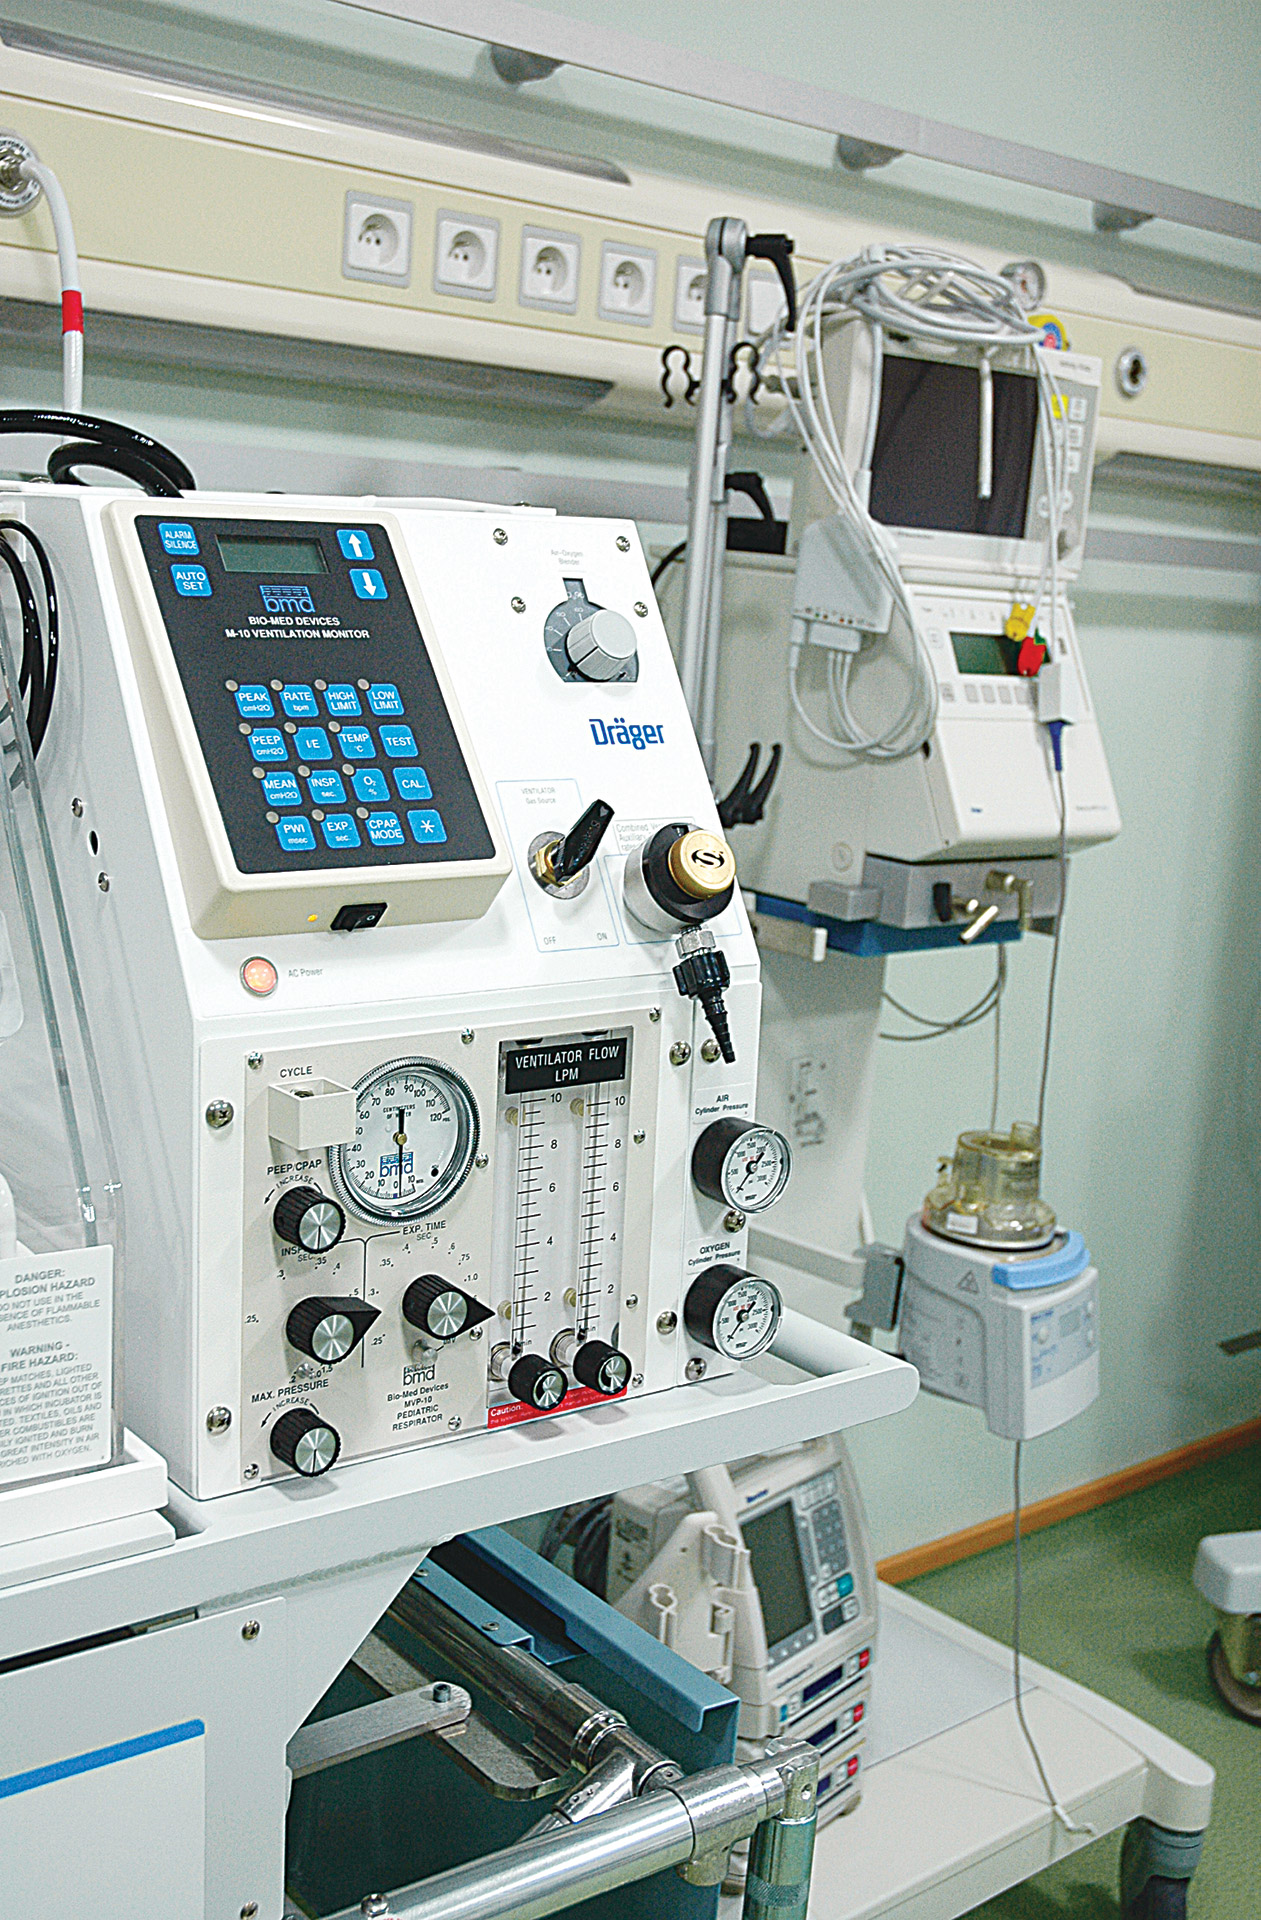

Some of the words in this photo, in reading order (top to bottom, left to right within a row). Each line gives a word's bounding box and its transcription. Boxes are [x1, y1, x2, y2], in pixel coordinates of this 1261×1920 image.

[164, 530, 192, 540] ALARM
[164, 540, 197, 550] SILENCE
[176, 572, 206, 581] AUTO
[182, 582, 204, 591] SET
[248, 616, 294, 626] BIO-MED
[296, 616, 340, 626] DEVICES
[224, 629, 250, 638] M-10
[251, 629, 321, 638] VENTILATION
[322, 630, 370, 638] MONITOR
[238, 692, 269, 702] PEAK
[284, 692, 312, 701] RATE
[328, 691, 354, 700] HIGH
[372, 690, 396, 700] LOW
[293, 704, 310, 713] bpm
[330, 702, 358, 711] LIMIT
[374, 700, 399, 710] LIMIT
[340, 733, 370, 743] TEMP
[588, 717, 665, 750] Dräger
[252, 736, 281, 745] PEEP
[386, 736, 412, 746] TEST
[264, 780, 297, 789] MEAN
[311, 778, 340, 788] INSP.
[402, 780, 426, 789] CAL.
[521, 786, 556, 795] VENTILATOR
[284, 824, 306, 834] PWI
[326, 821, 352, 832] EXP.
[369, 818, 397, 830] CPAP
[616, 823, 650, 833] Combined
[370, 828, 403, 840] MODE
[543, 935, 558, 946] OFF
[596, 932, 608, 942] ON
[288, 968, 300, 978] AC
[300, 966, 324, 978] Power
[515, 1049, 583, 1070] VENTILATOR
[588, 1045, 620, 1062] FLOW
[280, 1066, 313, 1078] CYCLE
[555, 1067, 579, 1083] LPM
[384, 1088, 395, 1096] 80
[404, 1084, 414, 1094] 90
[414, 1088, 426, 1098] 100
[371, 1098, 382, 1107] 70
[425, 1098, 436, 1108] 110
[550, 1092, 562, 1103] 10
[614, 1096, 626, 1106] 10
[716, 1094, 730, 1103] AIR
[359, 1110, 370, 1120] 60
[694, 1107, 720, 1116] Cylinder
[722, 1103, 749, 1111] Pressure
[430, 1112, 443, 1122] 120
[352, 1143, 362, 1153] 40
[550, 1139, 558, 1150] 8
[614, 1138, 622, 1150] 8
[355, 1160, 366, 1170] 30
[364, 1170, 375, 1180] 20
[378, 1179, 386, 1188] 10
[408, 1174, 416, 1184] 10
[275, 1174, 315, 1189] INCREASE
[548, 1182, 556, 1193] 6
[612, 1182, 620, 1192] 6
[402, 1225, 424, 1236] EXP.
[426, 1220, 447, 1231] TIME
[416, 1232, 432, 1242] SEC
[546, 1236, 554, 1246] 4
[610, 1232, 617, 1242] 4
[700, 1242, 731, 1255] OXYGEN
[688, 1256, 713, 1267] Cylinder
[716, 1250, 741, 1260] Pressure
[14, 1268, 66, 1284] DANGER:
[50, 1277, 96, 1292] HAZARD
[544, 1292, 552, 1302] 2
[608, 1284, 614, 1294] 2
[12, 1300, 31, 1310] NOT
[34, 1296, 52, 1306] USE
[66, 1292, 84, 1301] THE
[31, 1308, 44, 1318] OF
[46, 1299, 101, 1315] FLAMMABLE
[6, 1314, 72, 1332] ANESTHETICS.
[10, 1340, 64, 1358] WARNING
[0, 1360, 28, 1373] FIRE
[29, 1352, 79, 1368] HAZARD:
[56, 1363, 93, 1376] LIGHTED
[34, 1380, 52, 1390] AND
[54, 1377, 68, 1387] ALL
[70, 1372, 99, 1384] OTHER
[18, 1394, 30, 1404] OF
[32, 1388, 70, 1401] IGNITION
[72, 1383, 90, 1394] OUT
[91, 1381, 103, 1391] OF
[251, 1390, 276, 1404] MAX.
[278, 1378, 330, 1398] PRESSURE
[387, 1388, 418, 1402] Bio-Med
[420, 1382, 449, 1395] Devices
[14, 1402, 43, 1414] WHICH
[44, 1394, 92, 1409] INCUBATOR
[272, 1396, 310, 1412] INCREASE
[404, 1396, 433, 1408] MVP-10
[63, 1404, 83, 1416] OILS
[84, 1402, 102, 1412] AND
[396, 1404, 440, 1420] PEDIATRIC
[13, 1416, 78, 1435] COMBUSTIBLES
[79, 1412, 96, 1423] ARE
[392, 1414, 443, 1432] RESPIRATOR
[16, 1432, 50, 1445] IGNITED
[50, 1428, 68, 1439] AND
[70, 1424, 94, 1435] BURN
[30, 1437, 75, 1452] INTENSITY
[85, 1432, 100, 1442] AIR
[32, 1452, 53, 1462] WITH
